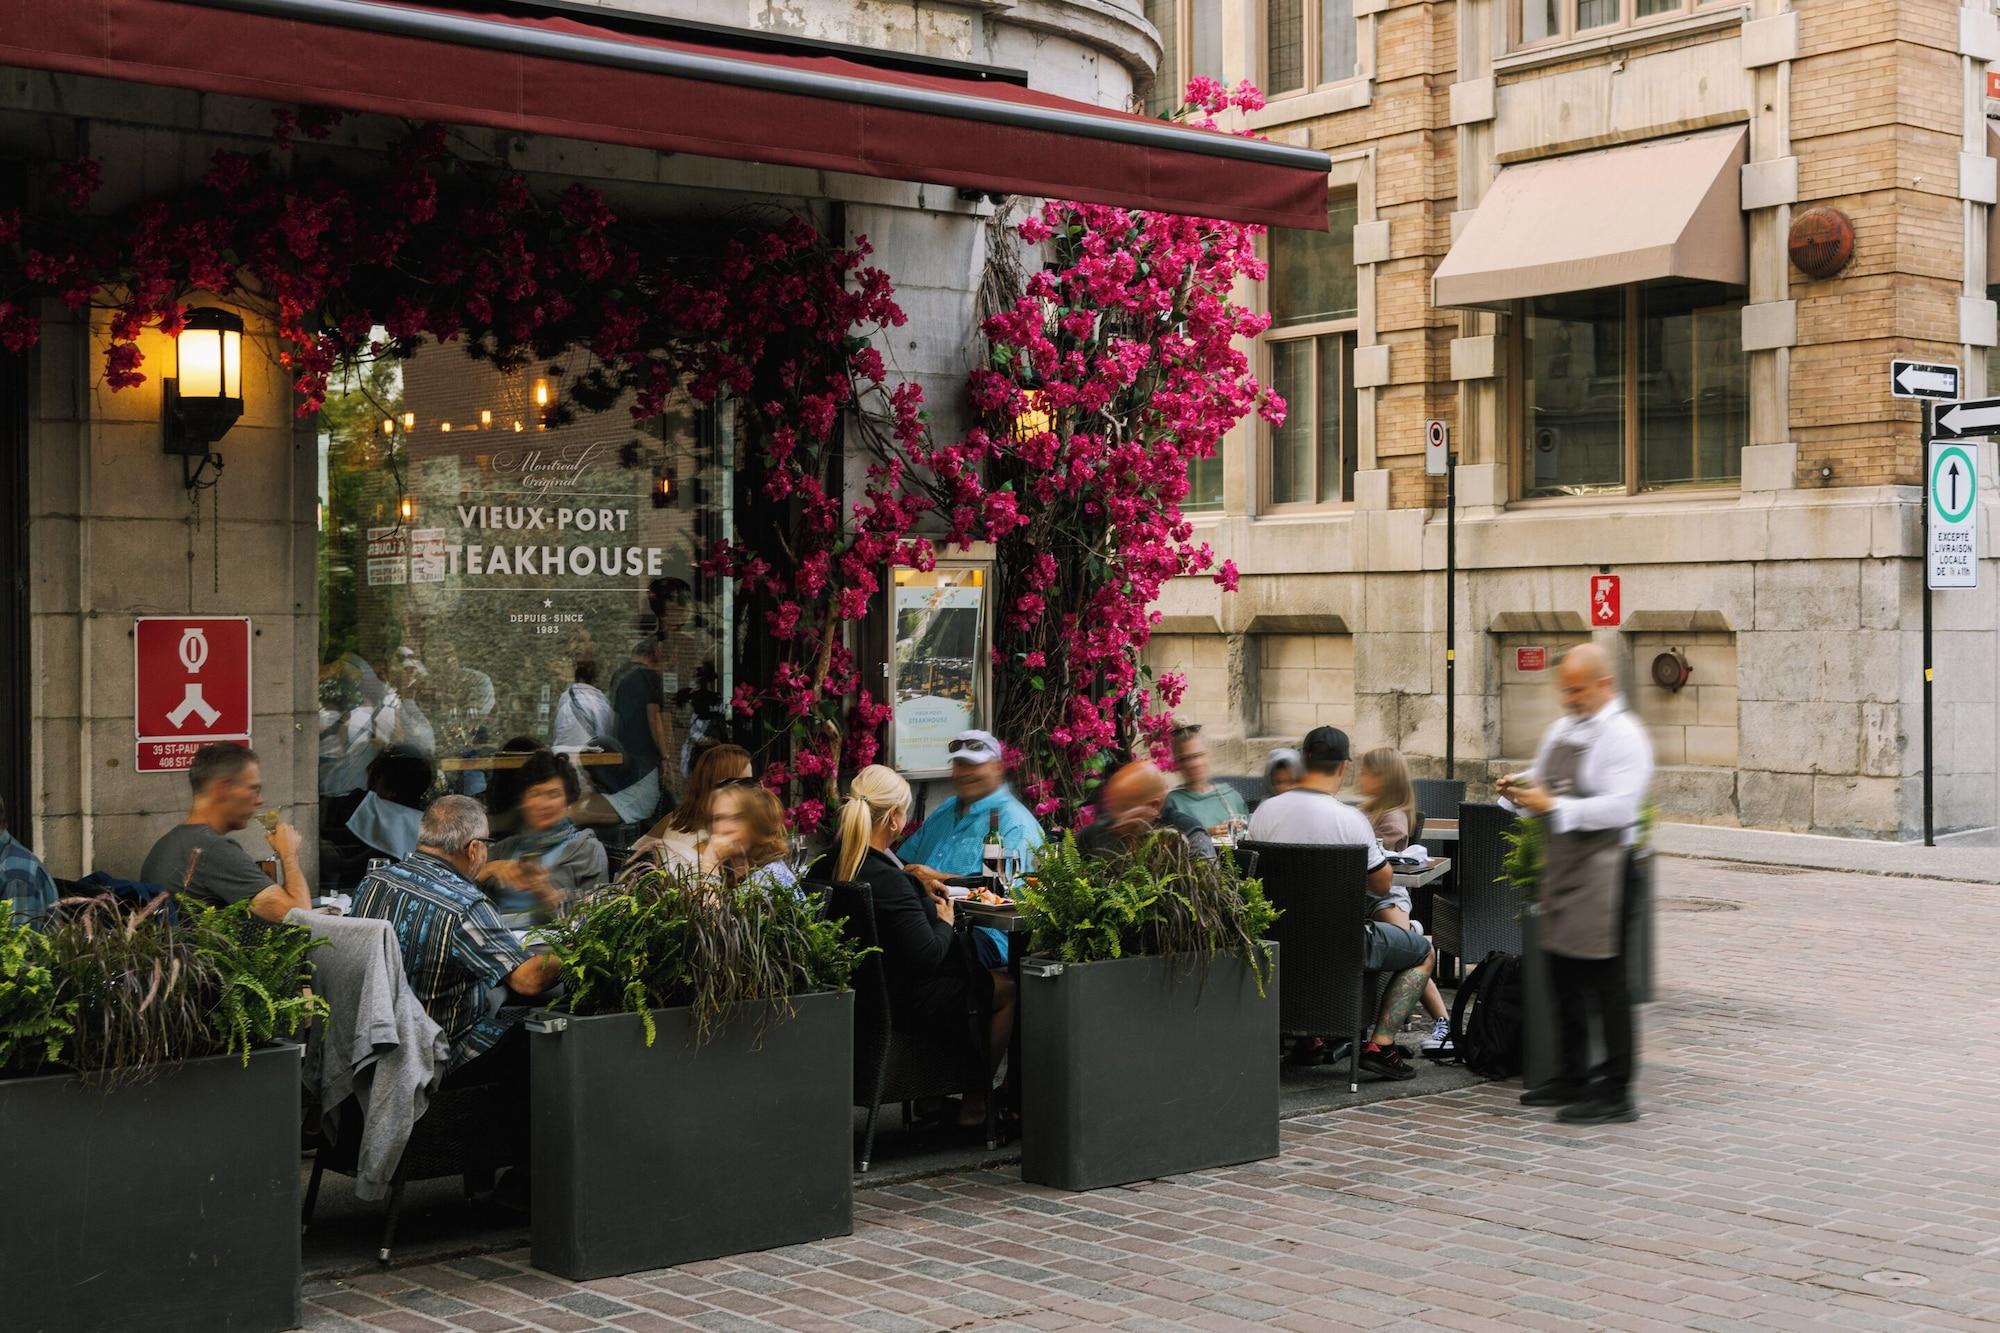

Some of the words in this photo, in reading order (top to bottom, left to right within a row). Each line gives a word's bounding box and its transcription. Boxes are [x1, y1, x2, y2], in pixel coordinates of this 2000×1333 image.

[522, 462, 592, 503] Original
[457, 505, 629, 532] VIEUX-PORT
[1938, 531, 1969, 541] EXCEPTÉ
[1935, 544, 1973, 553] LIVRAISON
[421, 546, 663, 577] STEAKHOUSE
[1939, 555, 1967, 565] LOCALE
[1937, 567, 1946, 576] DE
[510, 613, 547, 624] DEPUIS
[553, 613, 584, 623] SINCE
[535, 625, 560, 635] 1983
[152, 745, 163, 755] 39
[159, 757, 174, 768] 408
